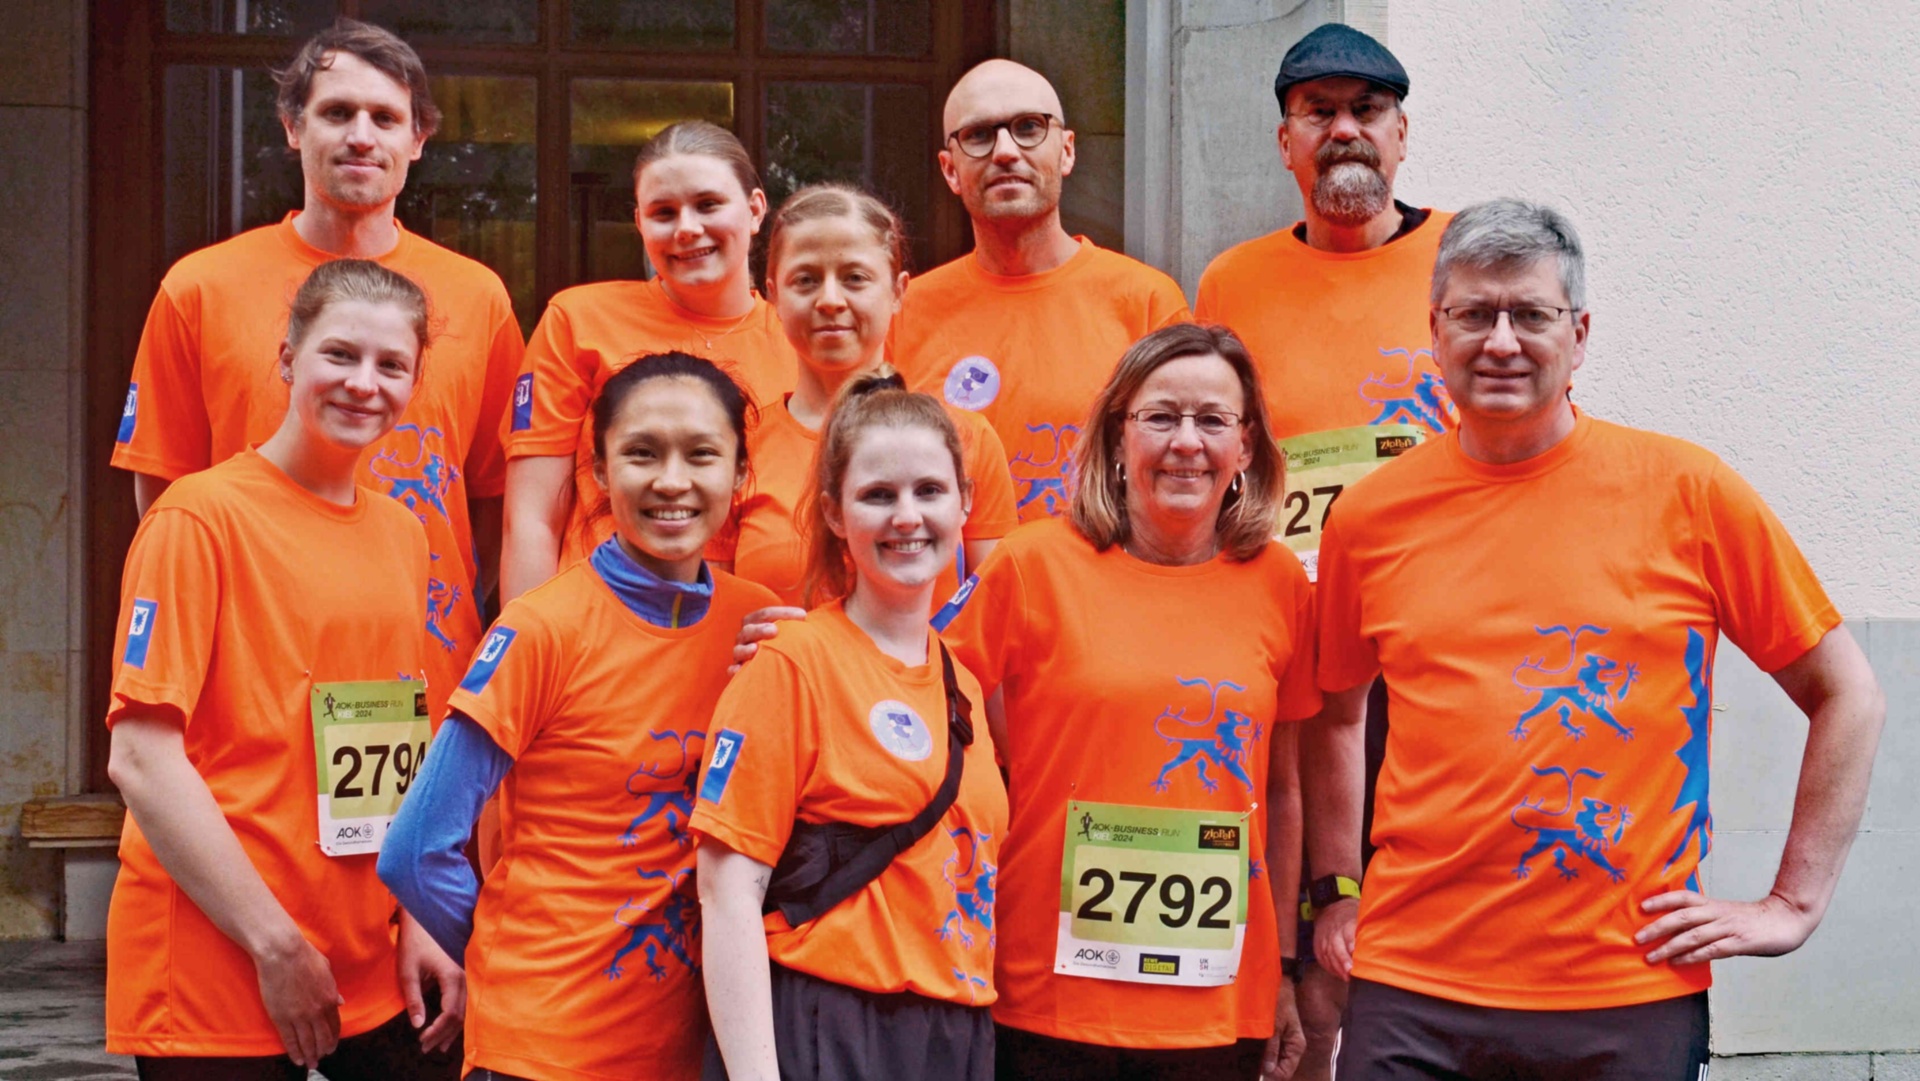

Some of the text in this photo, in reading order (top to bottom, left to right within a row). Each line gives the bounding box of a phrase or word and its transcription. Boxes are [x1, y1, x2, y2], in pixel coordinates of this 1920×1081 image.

[355, 710, 373, 718] 2024
[336, 826, 362, 839] AOK
[1112, 833, 1134, 842] 2024
[1077, 867, 1233, 930] 2792
[1074, 947, 1104, 962] AOK
[1144, 963, 1174, 973] DIGITAL
